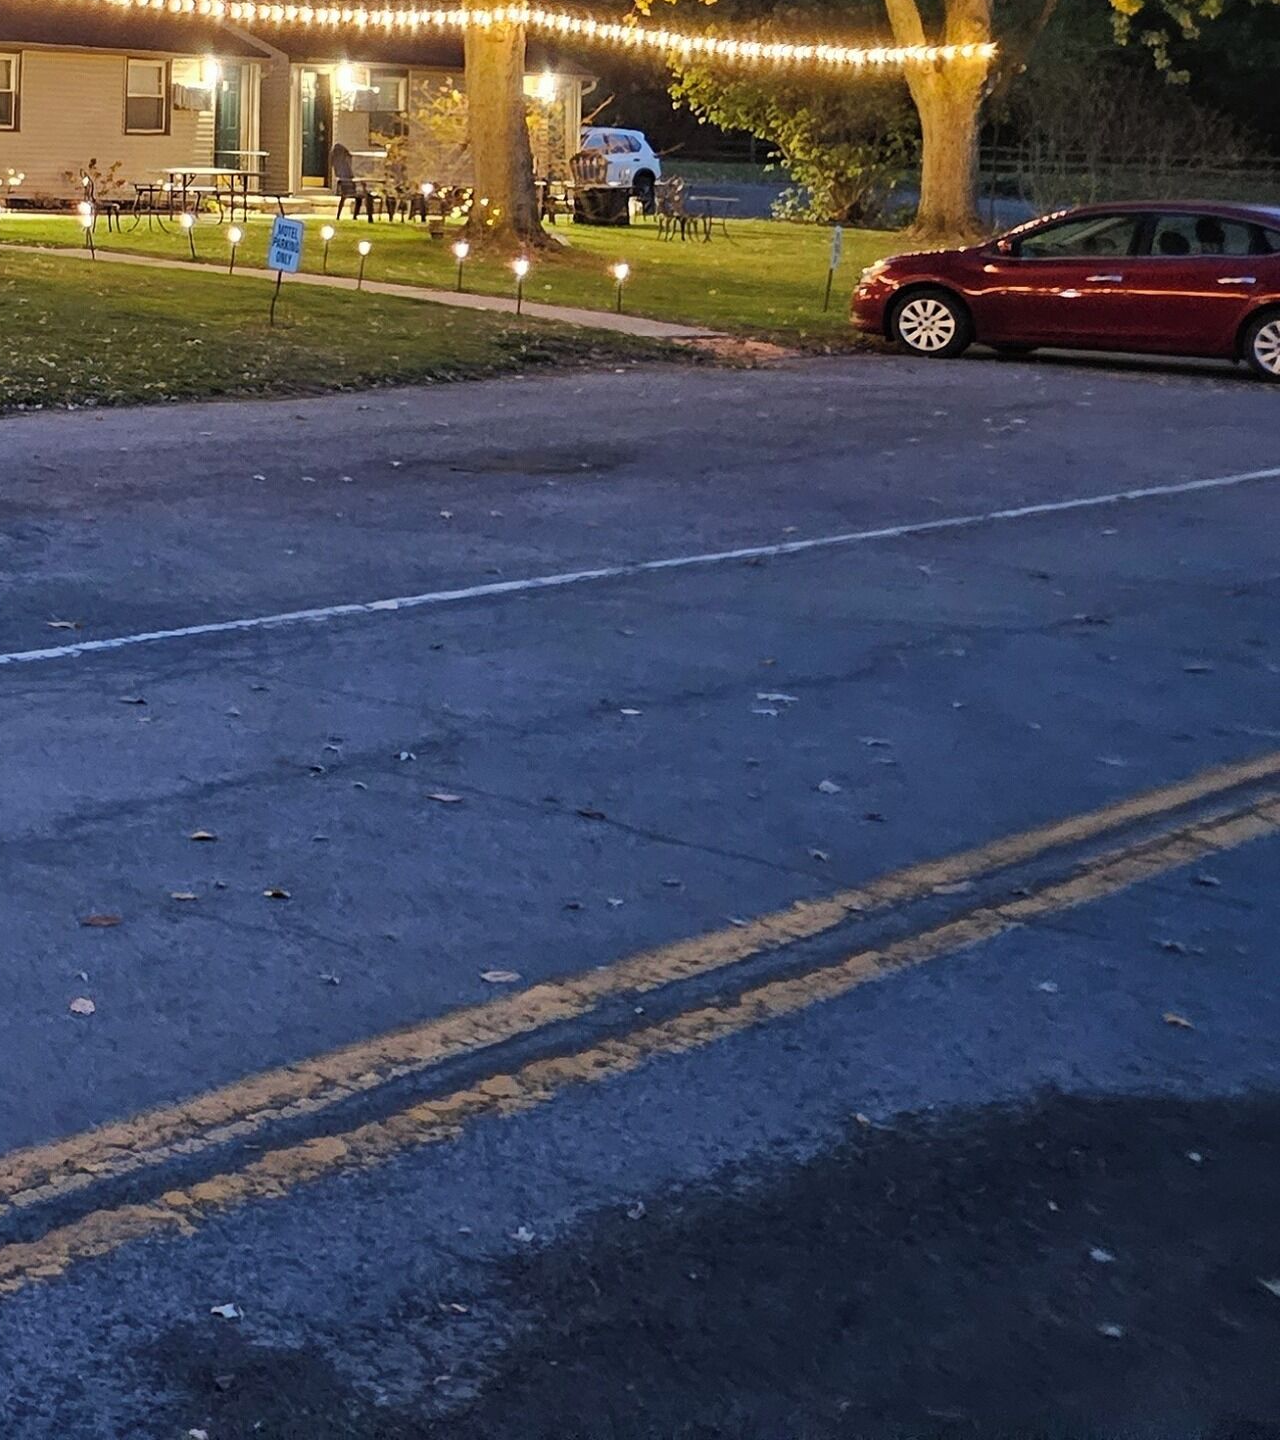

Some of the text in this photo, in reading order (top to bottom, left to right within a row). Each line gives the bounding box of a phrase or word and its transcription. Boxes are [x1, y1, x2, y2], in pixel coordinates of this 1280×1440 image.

[278, 223, 298, 240] MOTEL
[272, 236, 299, 253] PARKING
[276, 250, 292, 265] ONLY
